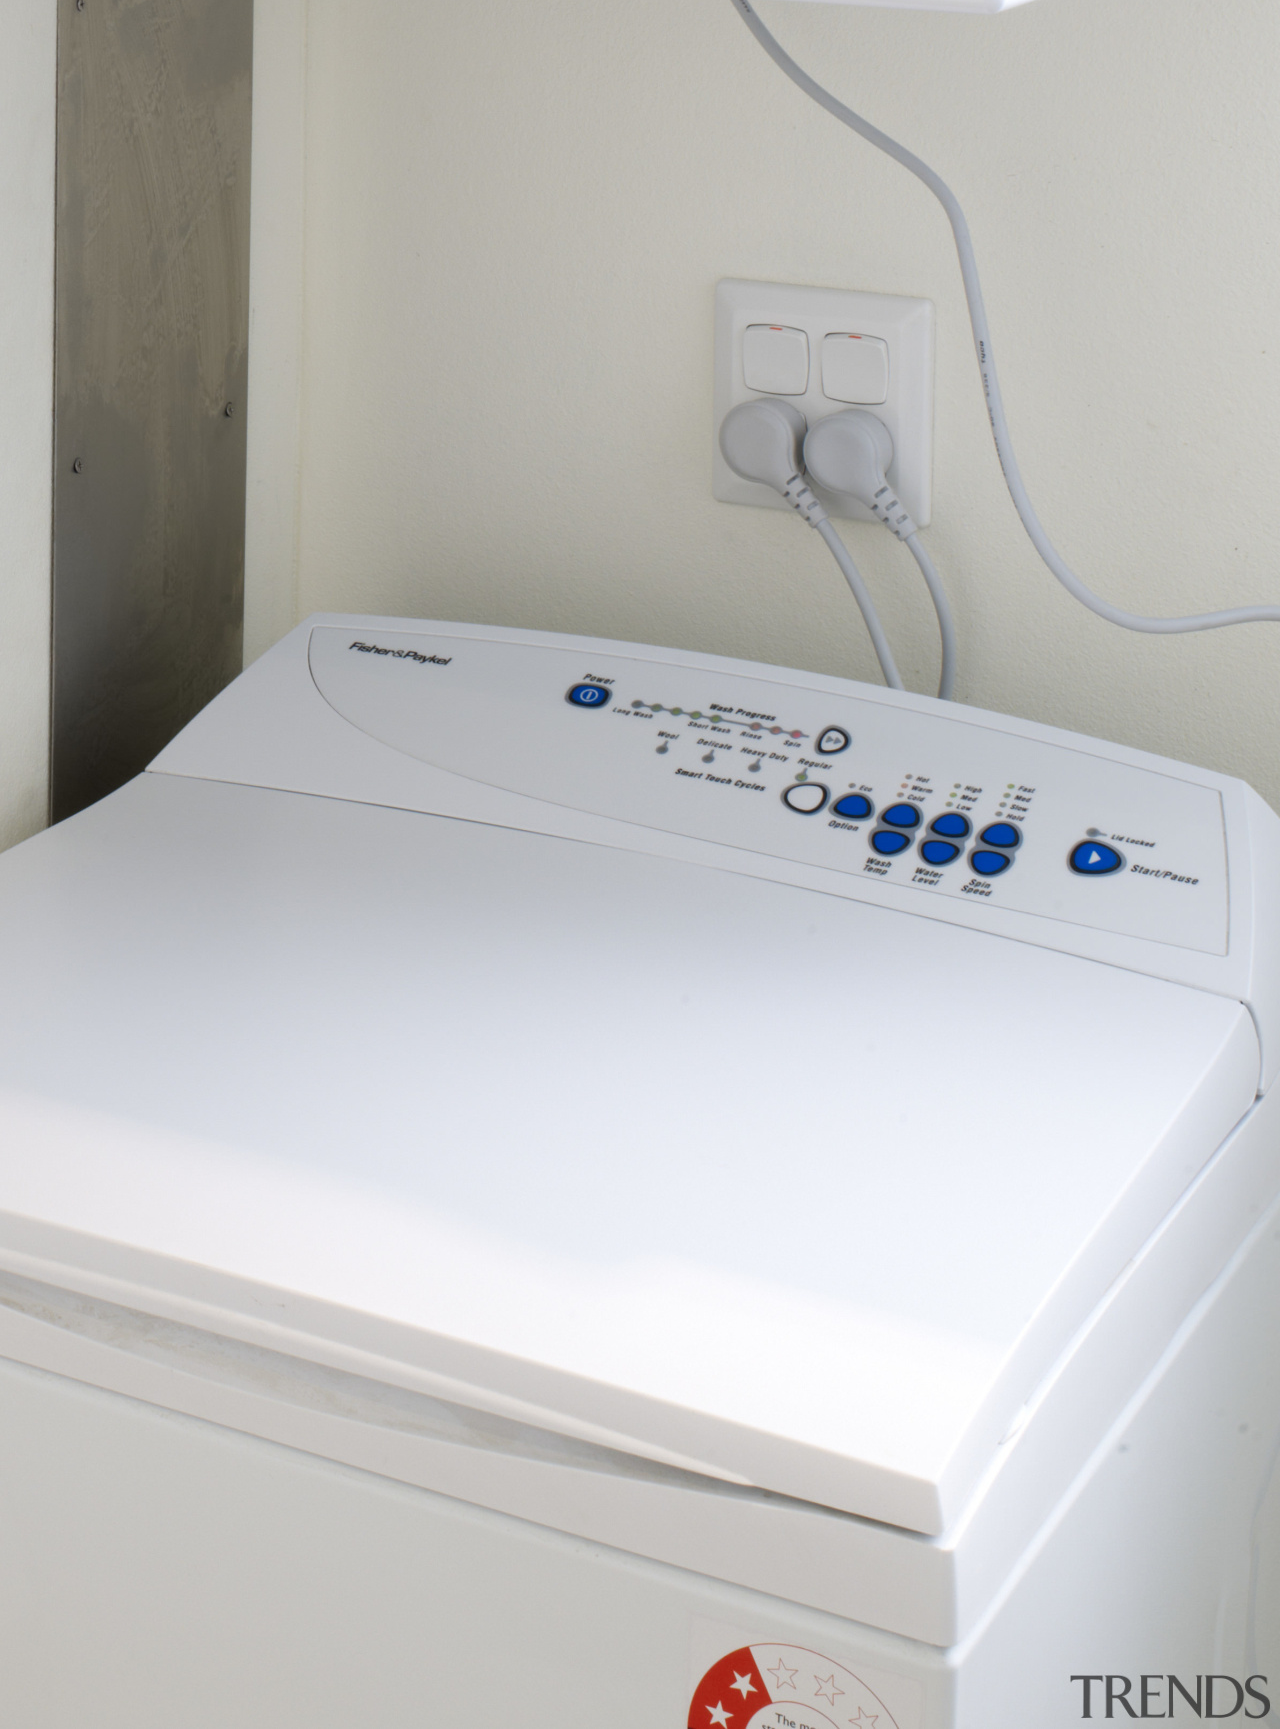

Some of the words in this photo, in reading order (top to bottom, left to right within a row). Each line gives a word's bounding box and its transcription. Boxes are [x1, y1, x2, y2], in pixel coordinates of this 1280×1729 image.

[349, 641, 452, 666] Fisher&Paykel
[583, 673, 615, 685] Power
[612, 707, 631, 716] Long
[633, 710, 654, 719] Wash
[709, 703, 733, 713] Wash
[736, 709, 776, 721] Progress
[688, 721, 709, 730] Short
[710, 725, 731, 733] Wash
[657, 731, 680, 740] Wool
[740, 731, 762, 740] Rinse
[697, 738, 733, 750] Delicate
[783, 740, 802, 748] Spin
[740, 747, 767, 758] Heavy
[769, 752, 789, 762] Duty
[797, 758, 833, 770] Regular
[675, 768, 703, 779] Smart
[705, 774, 732, 784] Touch
[734, 780, 766, 792] Cycles
[911, 785, 934, 794] Warm
[964, 785, 982, 793] High
[907, 794, 926, 802] Cold
[1014, 795, 1032, 803] Med
[1010, 804, 1029, 812] Slow
[1006, 813, 1025, 822] Hold
[828, 819, 859, 831] Option
[1126, 837, 1155, 847] Locked
[866, 857, 892, 868] Wash
[863, 864, 888, 875] Temp
[915, 867, 944, 878] Water
[1131, 864, 1199, 885] Start/Pause
[911, 875, 940, 886] Level
[969, 878, 991, 889] Spin
[961, 885, 992, 897] Speed
[775, 1712, 796, 1728] The
